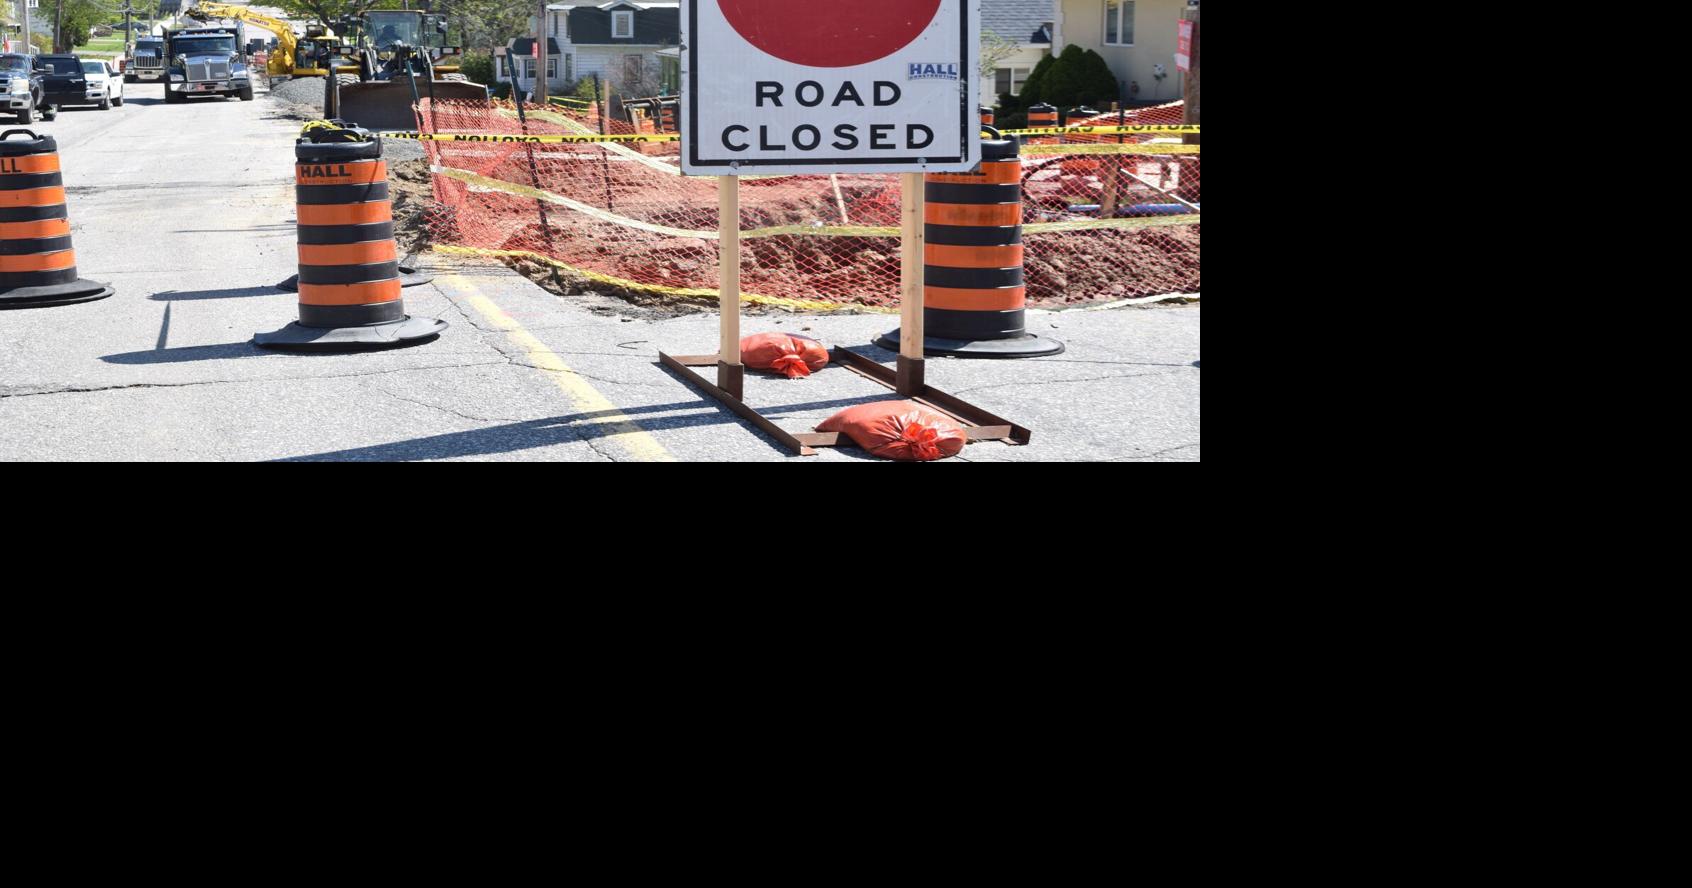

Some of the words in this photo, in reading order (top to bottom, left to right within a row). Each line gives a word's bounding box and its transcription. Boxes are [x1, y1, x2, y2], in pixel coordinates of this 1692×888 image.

[910, 63, 957, 75] HALL
[755, 80, 902, 107] ROAD
[721, 124, 934, 152] CLOSED
[1, 158, 22, 173] LL
[301, 164, 352, 178] HALL
